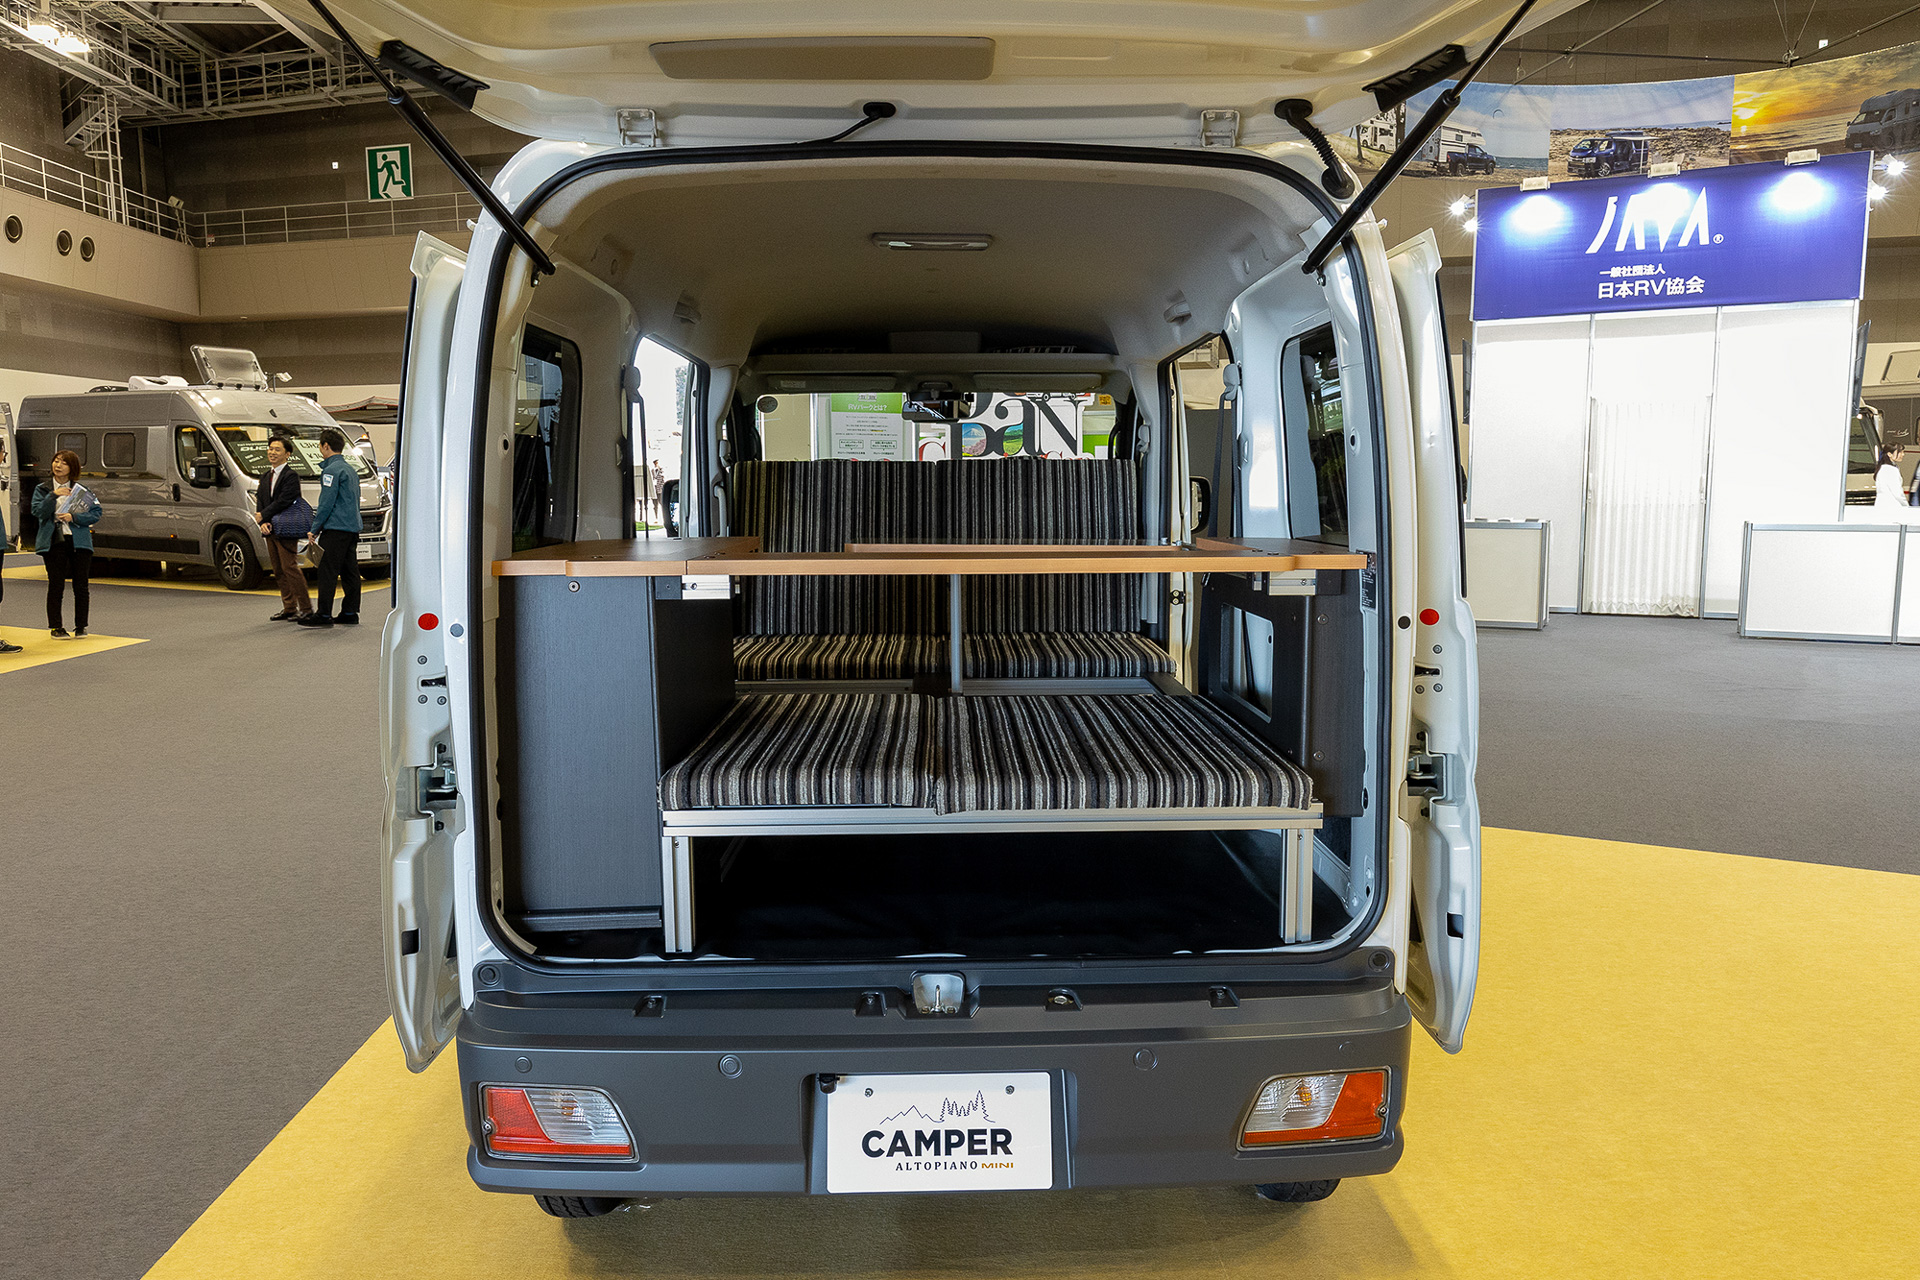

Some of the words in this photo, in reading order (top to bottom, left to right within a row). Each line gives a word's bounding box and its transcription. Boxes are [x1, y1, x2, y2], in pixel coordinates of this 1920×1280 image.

[1599, 263, 1666, 278] 一般社団法人
[1597, 275, 1706, 299] 日本RV協会
[861, 1128, 1013, 1158] CAMPER
[895, 1160, 978, 1171] ALTOPIANO
